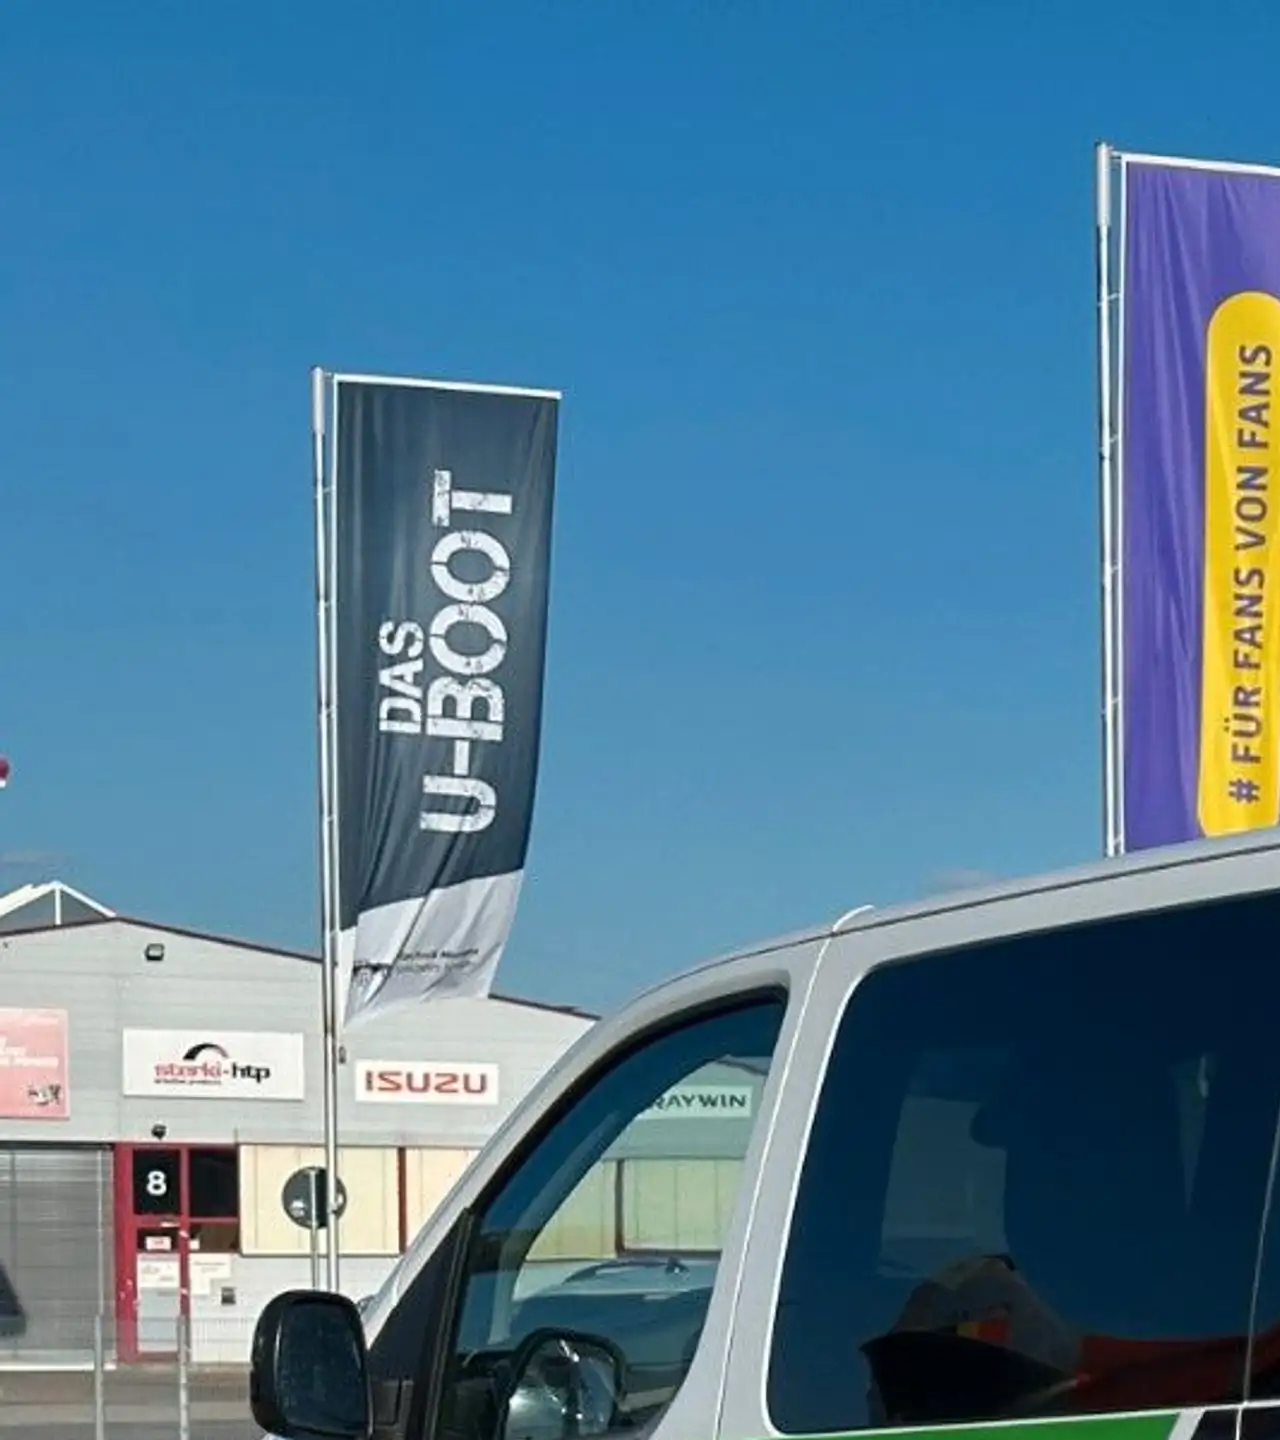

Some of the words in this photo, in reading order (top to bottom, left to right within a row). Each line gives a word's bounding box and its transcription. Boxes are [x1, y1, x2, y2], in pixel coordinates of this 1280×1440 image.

[1238, 344, 1272, 449] FANS
[1234, 465, 1269, 551] VON
[419, 469, 513, 835] U-BOOT
[1233, 567, 1265, 671] FANS
[379, 618, 425, 734] DAS
[1224, 685, 1262, 764] FÜR
[365, 1070, 487, 1094] ISUZU
[146, 1170, 167, 1196] 8
